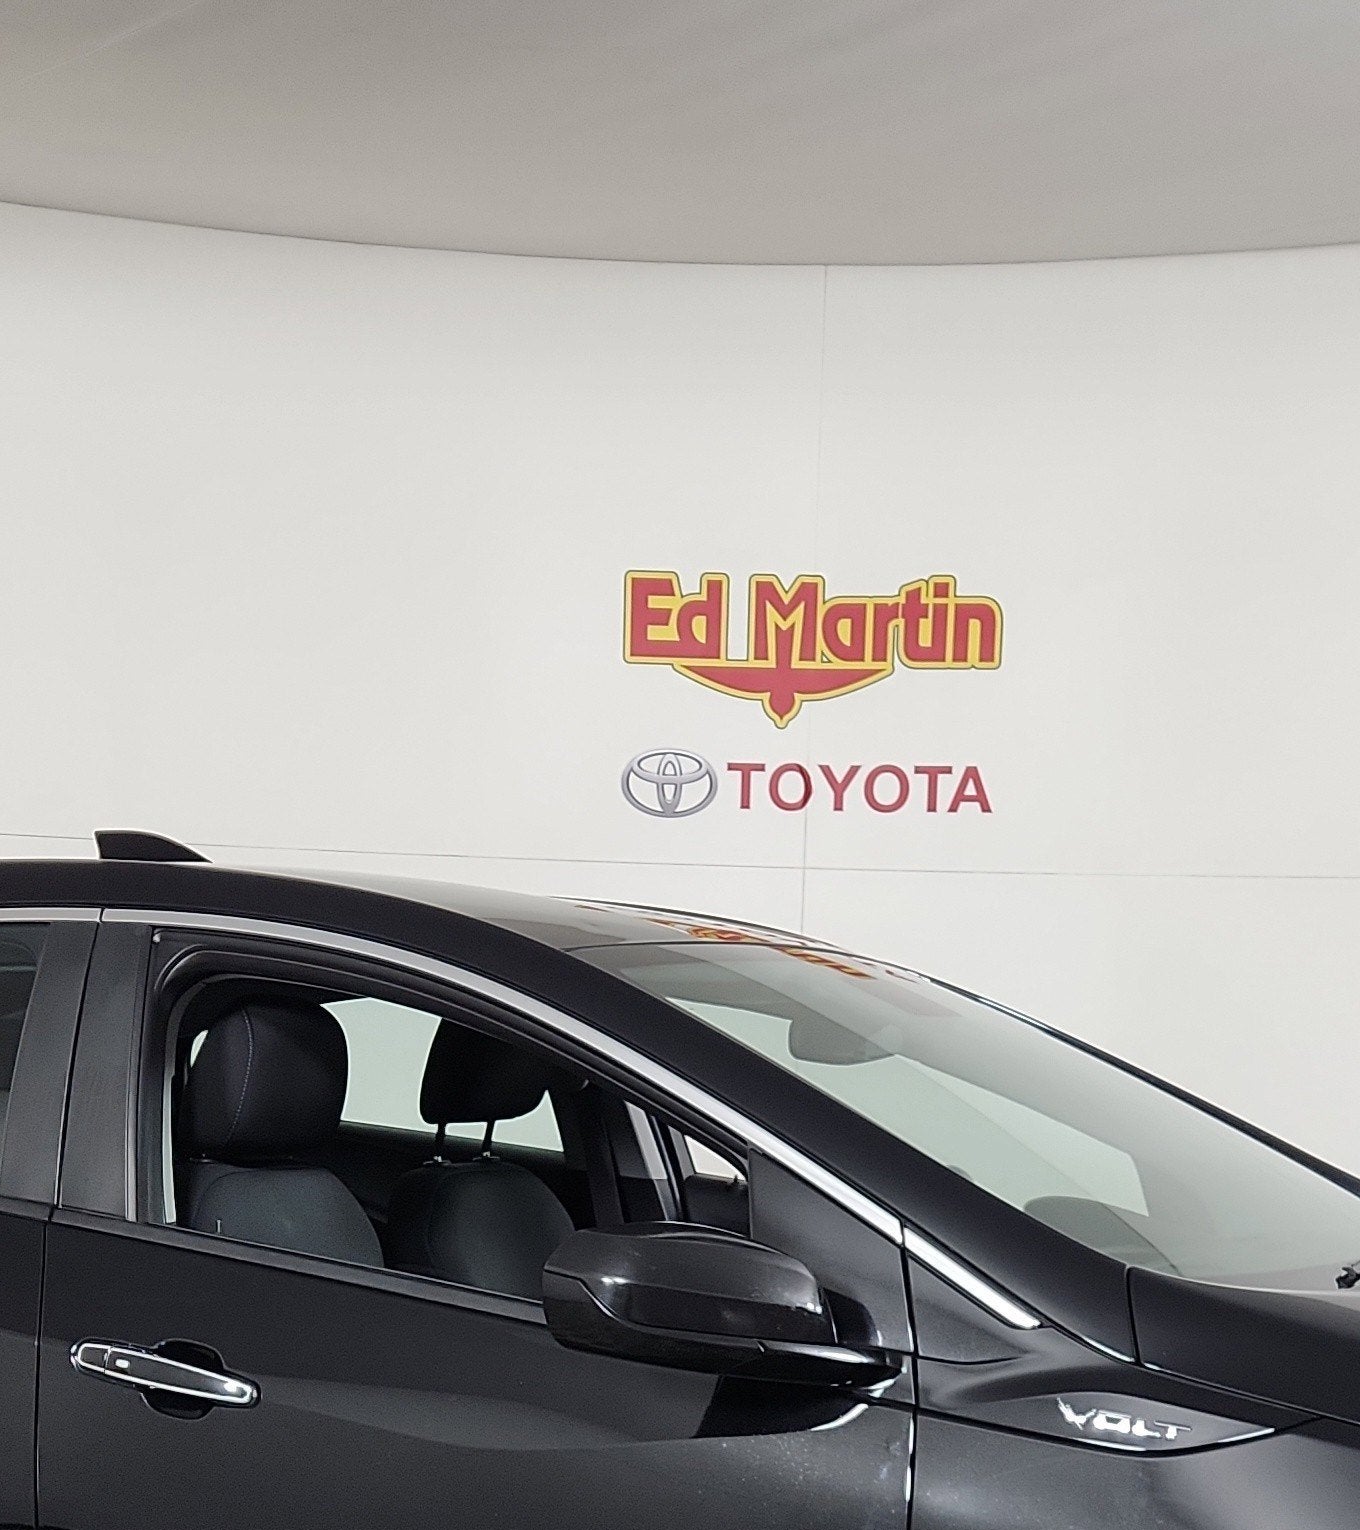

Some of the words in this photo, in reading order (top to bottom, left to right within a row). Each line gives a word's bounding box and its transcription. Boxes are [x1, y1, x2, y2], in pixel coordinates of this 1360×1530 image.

[626, 573, 727, 662] Ed
[751, 575, 1000, 667] Martin
[727, 762, 994, 814] TOYOTA
[1056, 1397, 1193, 1441] VOLT
